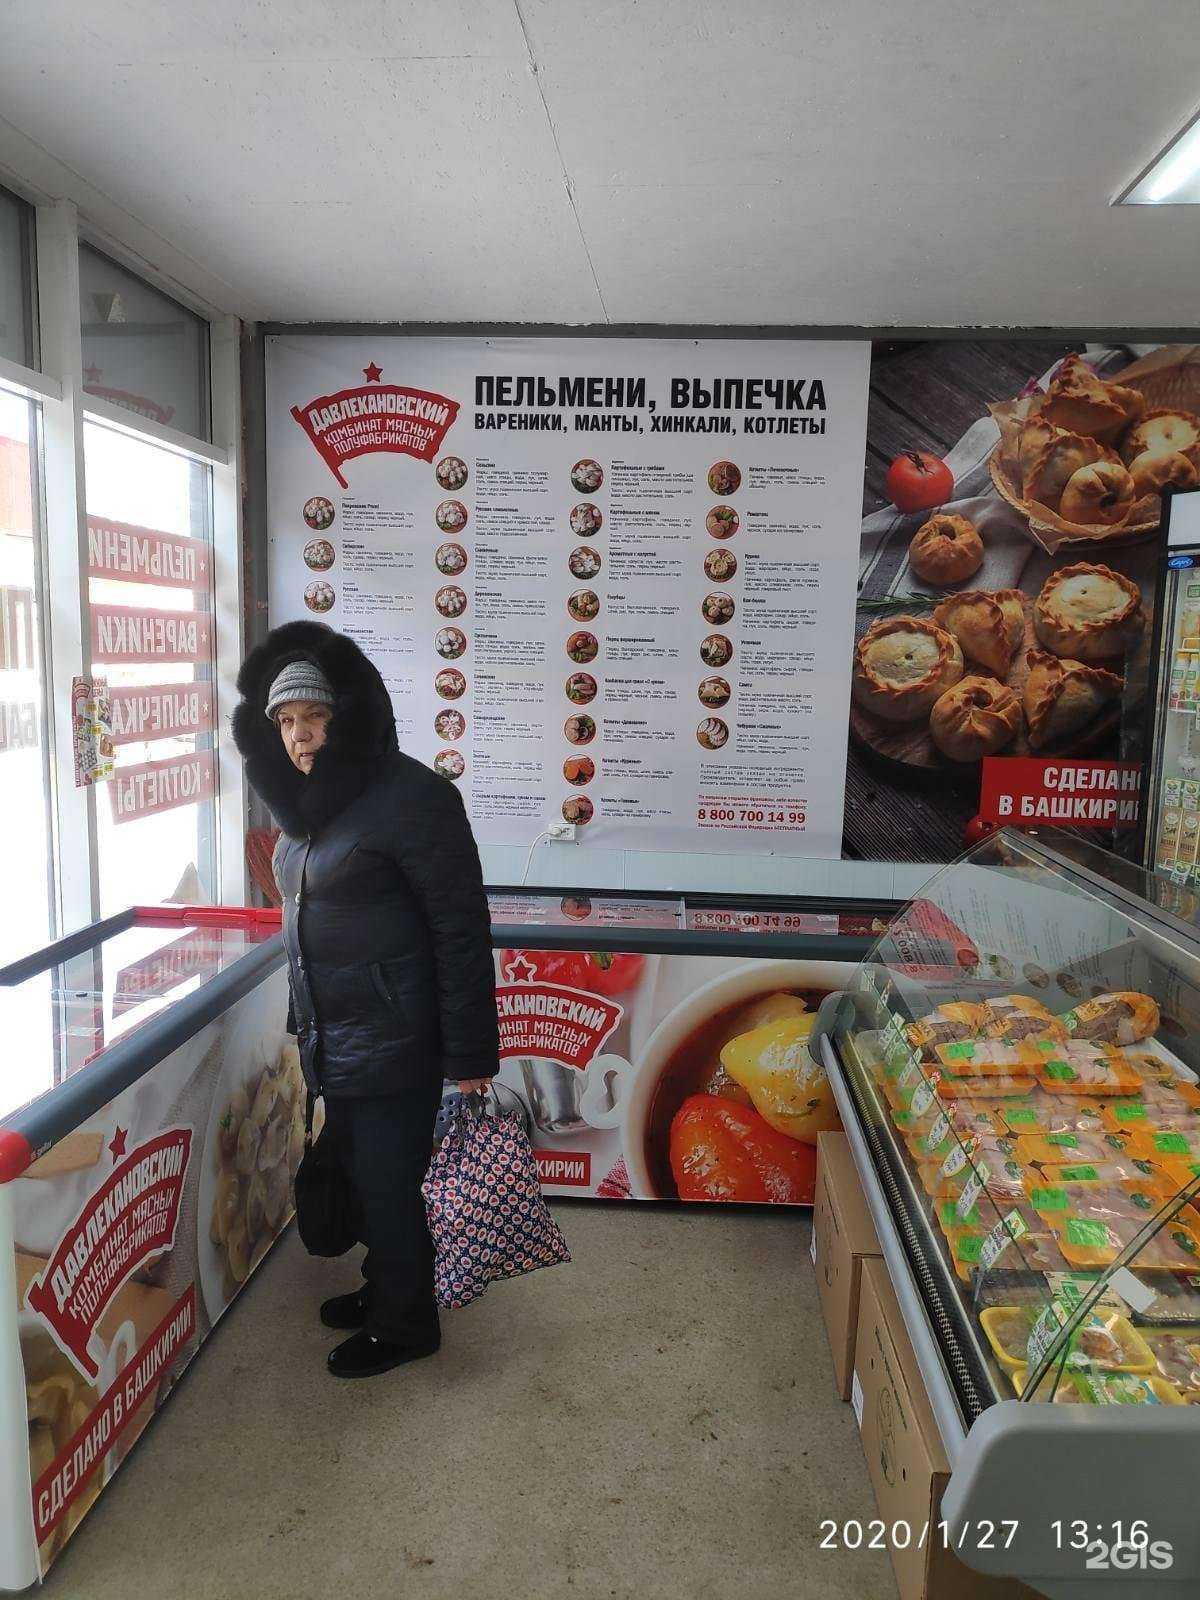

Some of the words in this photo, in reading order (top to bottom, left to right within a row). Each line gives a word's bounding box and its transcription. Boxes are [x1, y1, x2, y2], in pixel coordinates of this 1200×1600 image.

[475, 376, 657, 413] ПЕЛЬМЕНИ,
[670, 378, 827, 411] ВЫПЕЧКА
[309, 394, 449, 436] ДАВЛЕКАНОВСКИЙ
[474, 413, 568, 433] ВАРЕНИКИ,
[574, 415, 644, 434] МАНТЫ,
[650, 416, 737, 436] ХИНКАЛИ,
[744, 417, 826, 435] КОТЛЕТЫ
[324, 418, 382, 446] КОМБИНАТ
[386, 419, 437, 441] МЯСНЫХ
[333, 432, 428, 456] ПОЛУФАБРИКАТОВ
[1043, 767, 1141, 792] СДЕЛАН
[697, 808, 706, 820] 8
[709, 809, 735, 821] 800
[739, 810, 764, 822] 700
[767, 811, 785, 823] 14
[788, 812, 806, 824] 99
[998, 795, 1013, 816] В
[496, 994, 607, 1032] ЕКАНОВСКИЙ
[497, 1020, 531, 1035] ИНАТ
[533, 1020, 592, 1048] МЯСНЫХ
[498, 1034, 581, 1058] УФАБРИКАТОВ
[536, 1159, 585, 1179] КИРИИ
[50, 1138, 184, 1314] ДАВЛЕКАНОВСКИЙ
[69, 1216, 129, 1319] КОМБИНАТ
[132, 1187, 176, 1227] МЯСНЫХ
[80, 1211, 168, 1325] ПОЛУФАБРИКАТОВ
[38, 1410, 111, 1528] СДЕЛАНО
[113, 1393, 123, 1428] В
[126, 1301, 192, 1411] БАШКИРИИ
